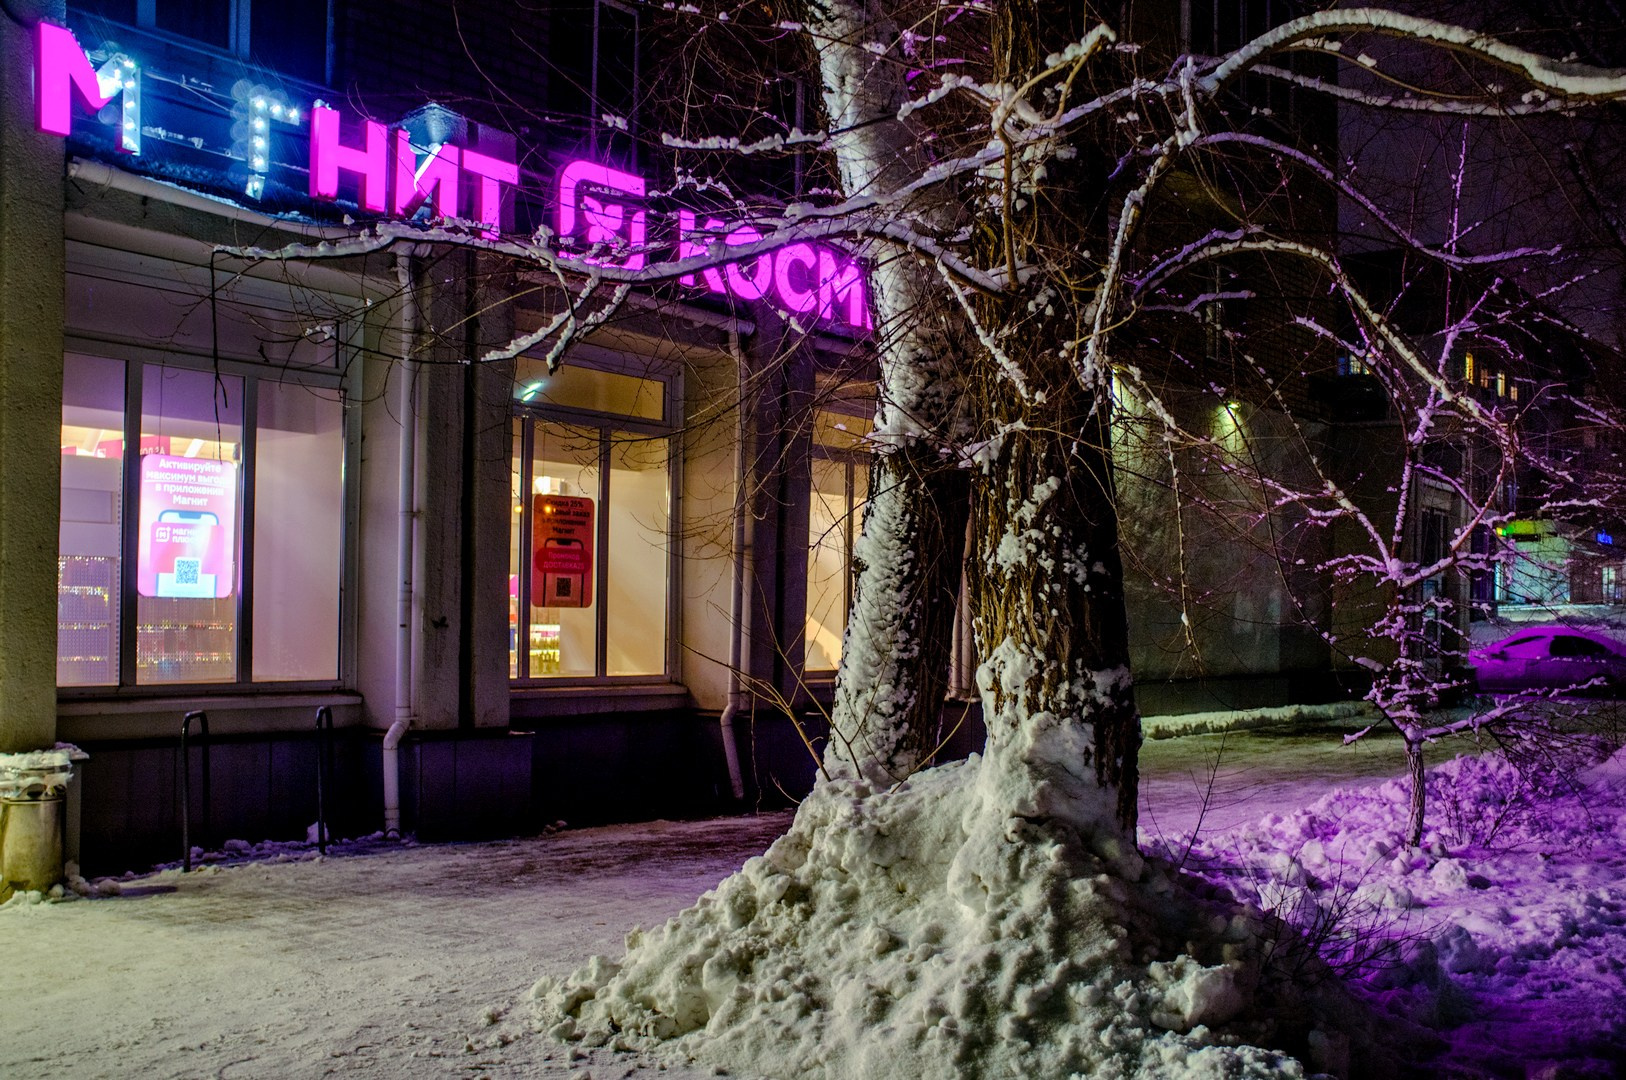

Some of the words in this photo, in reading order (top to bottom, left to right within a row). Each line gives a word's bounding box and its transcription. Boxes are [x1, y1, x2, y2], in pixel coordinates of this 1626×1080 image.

[35, 20, 518, 240] МГНИТ
[679, 208, 874, 330] КОСМ
[159, 458, 222, 473] Активируйте
[145, 471, 196, 484] максимум
[197, 475, 231, 487] выгод
[163, 484, 225, 496] приложении
[173, 495, 208, 507] Магнит
